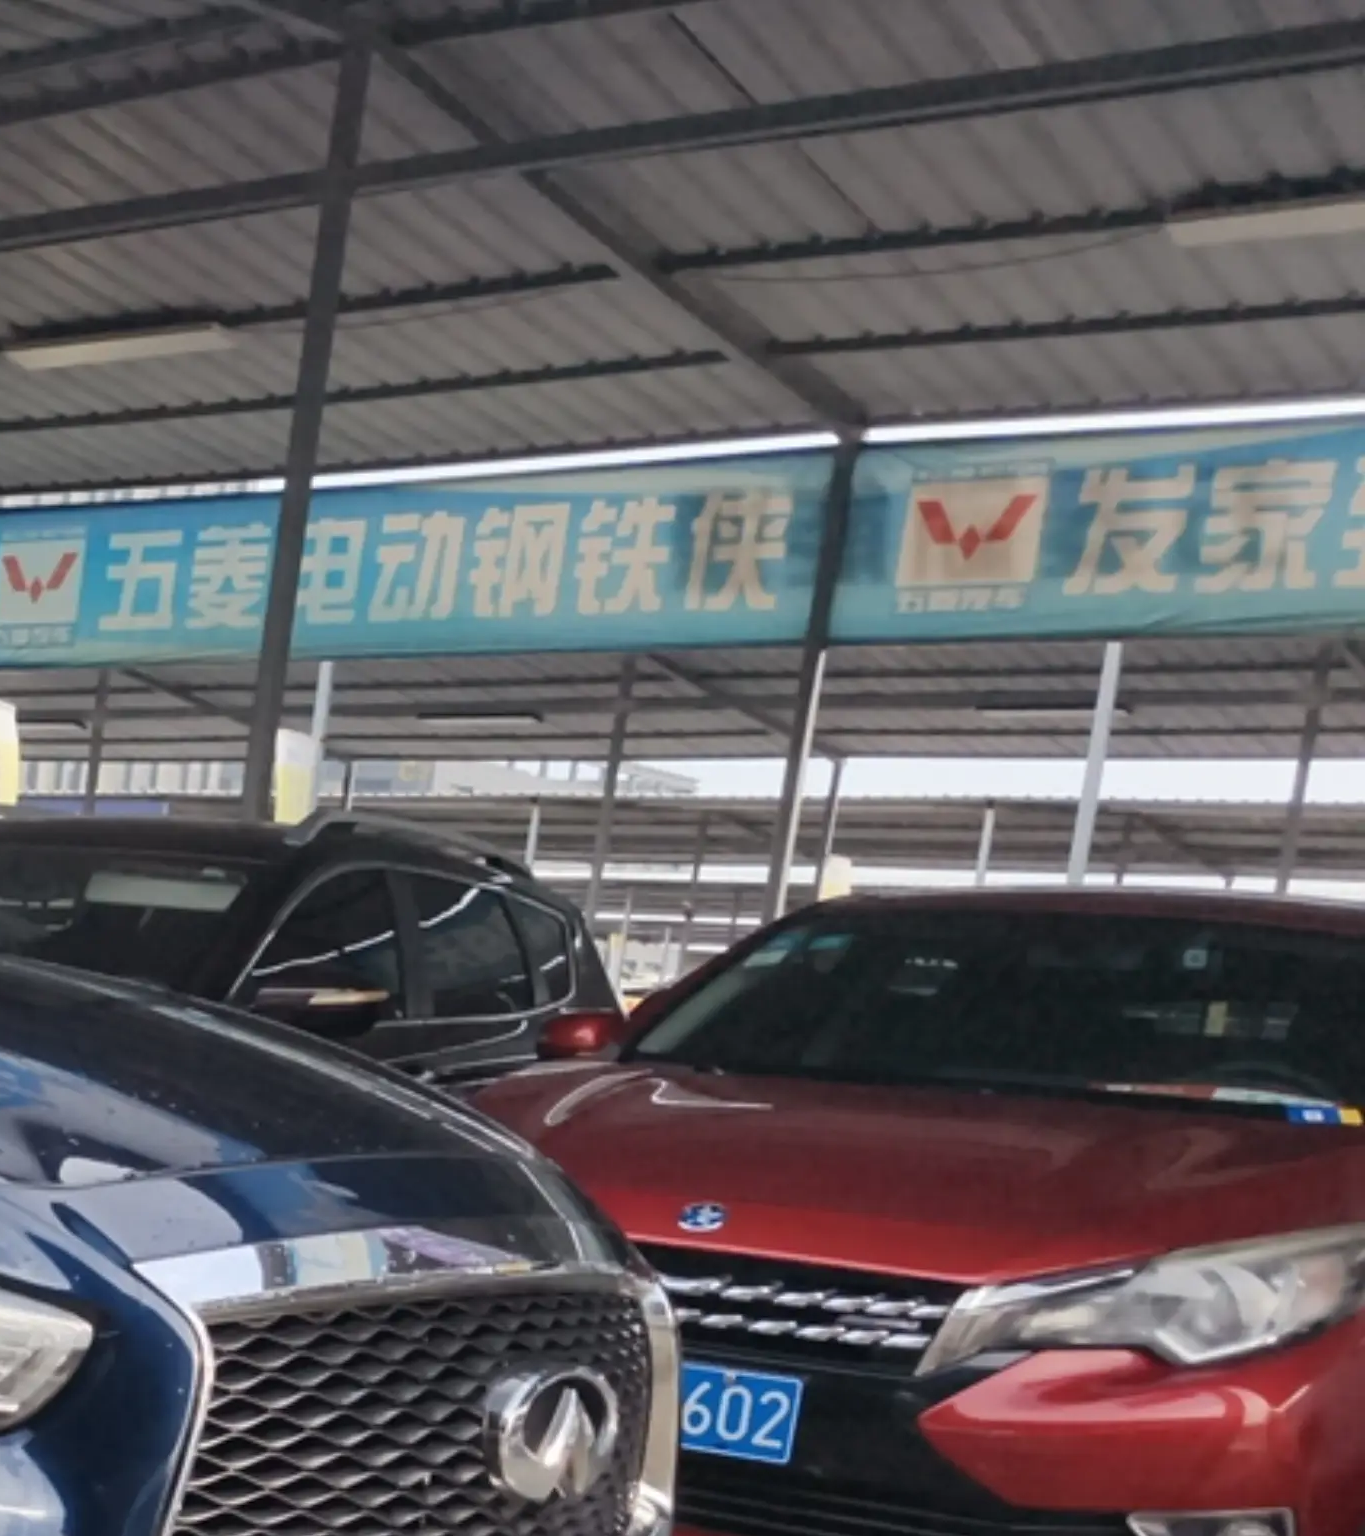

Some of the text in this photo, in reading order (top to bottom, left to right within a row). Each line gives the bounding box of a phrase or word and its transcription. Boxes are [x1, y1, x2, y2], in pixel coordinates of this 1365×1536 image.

[98, 488, 792, 632] 五菱电动钢铁侠
[1062, 456, 1365, 598] 发家
[681, 1380, 791, 1450] 602
